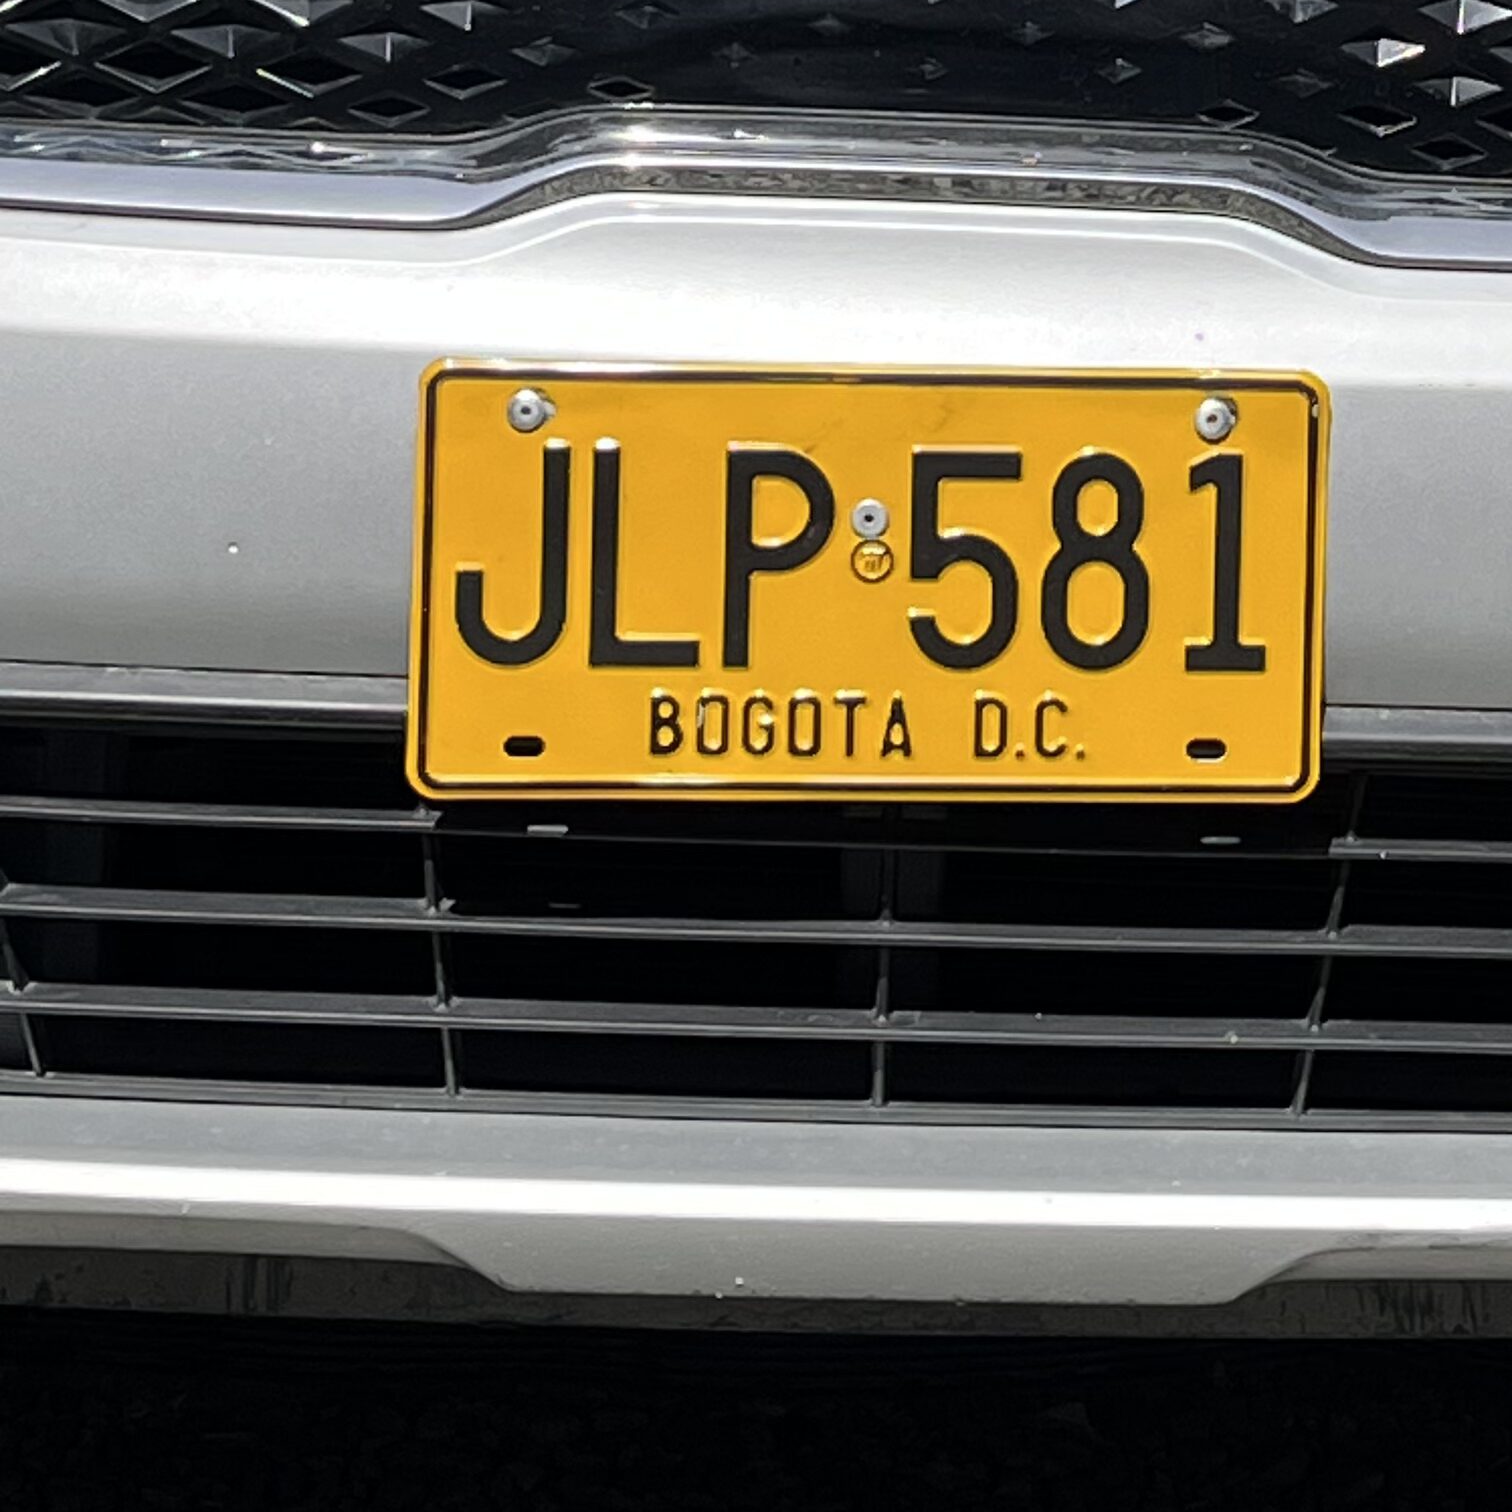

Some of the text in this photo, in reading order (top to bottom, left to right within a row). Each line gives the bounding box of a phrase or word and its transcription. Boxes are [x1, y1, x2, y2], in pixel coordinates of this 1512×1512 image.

[453, 439, 1268, 672] JLP 581
[648, 688, 1087, 761] BOGOTA D.C.
